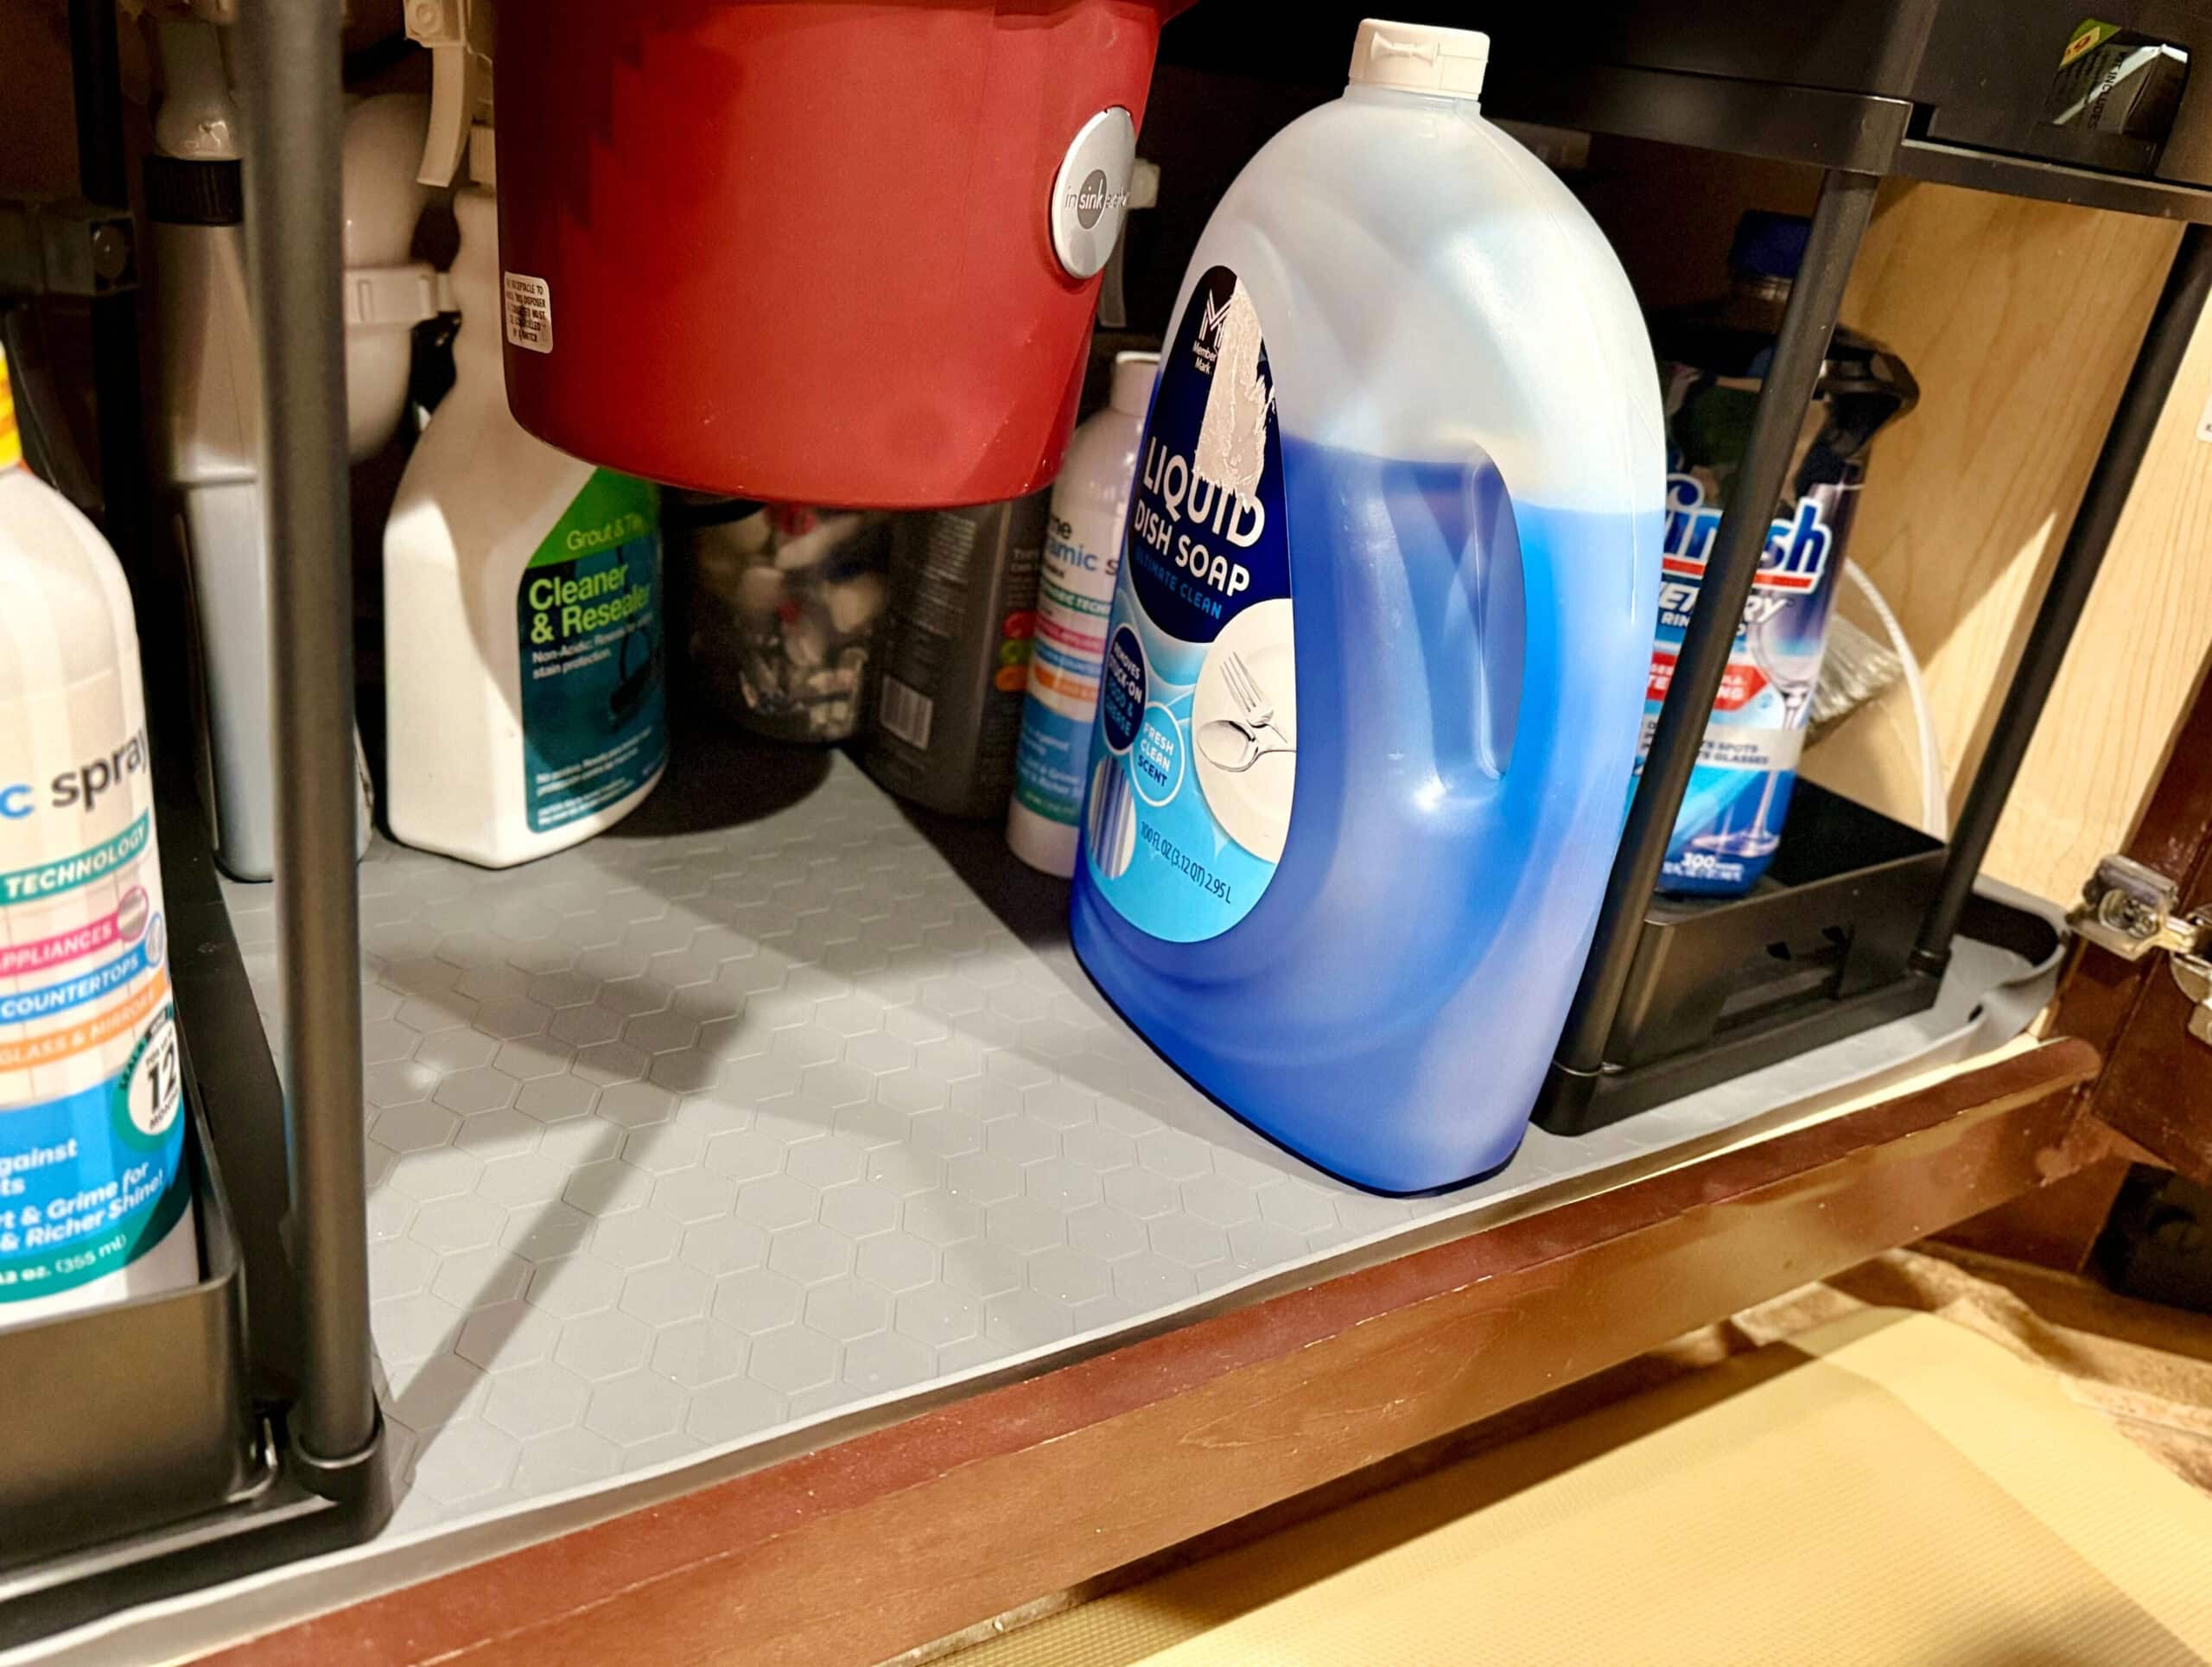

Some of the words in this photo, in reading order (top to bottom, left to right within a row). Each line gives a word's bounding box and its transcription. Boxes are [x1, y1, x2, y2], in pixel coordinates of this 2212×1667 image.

[2087, 70, 2118, 130] INCLUDES
[1142, 436, 1265, 548] LIQUID
[567, 523, 612, 550] Grout
[1133, 499, 1173, 557] DISH
[1174, 534, 1250, 597] SOAP
[529, 563, 629, 610] Cleaner
[530, 612, 555, 645] &
[562, 582, 652, 639] Resealer
[1179, 582, 1223, 620] CLEAN
[1140, 740, 1171, 773] CLEAN
[1142, 722, 1174, 756] FRESH
[0, 783, 35, 820] c
[1137, 754, 1168, 788] SCENT
[4, 824, 146, 899] TECHNOLOGY
[1140, 820, 1153, 843] 100
[1160, 838, 1172, 861] OZ
[1205, 873, 1225, 899] 2.95
[0, 953, 139, 1019] COUNTERTOPS
[148, 1040, 176, 1116] 12
[0, 1231, 20, 1251] &
[25, 1209, 106, 1248] Richer
[108, 1168, 163, 1220] Shine!
[21, 1205, 41, 1226] &
[47, 1180, 119, 1219] Grime
[123, 1161, 149, 1195] for
